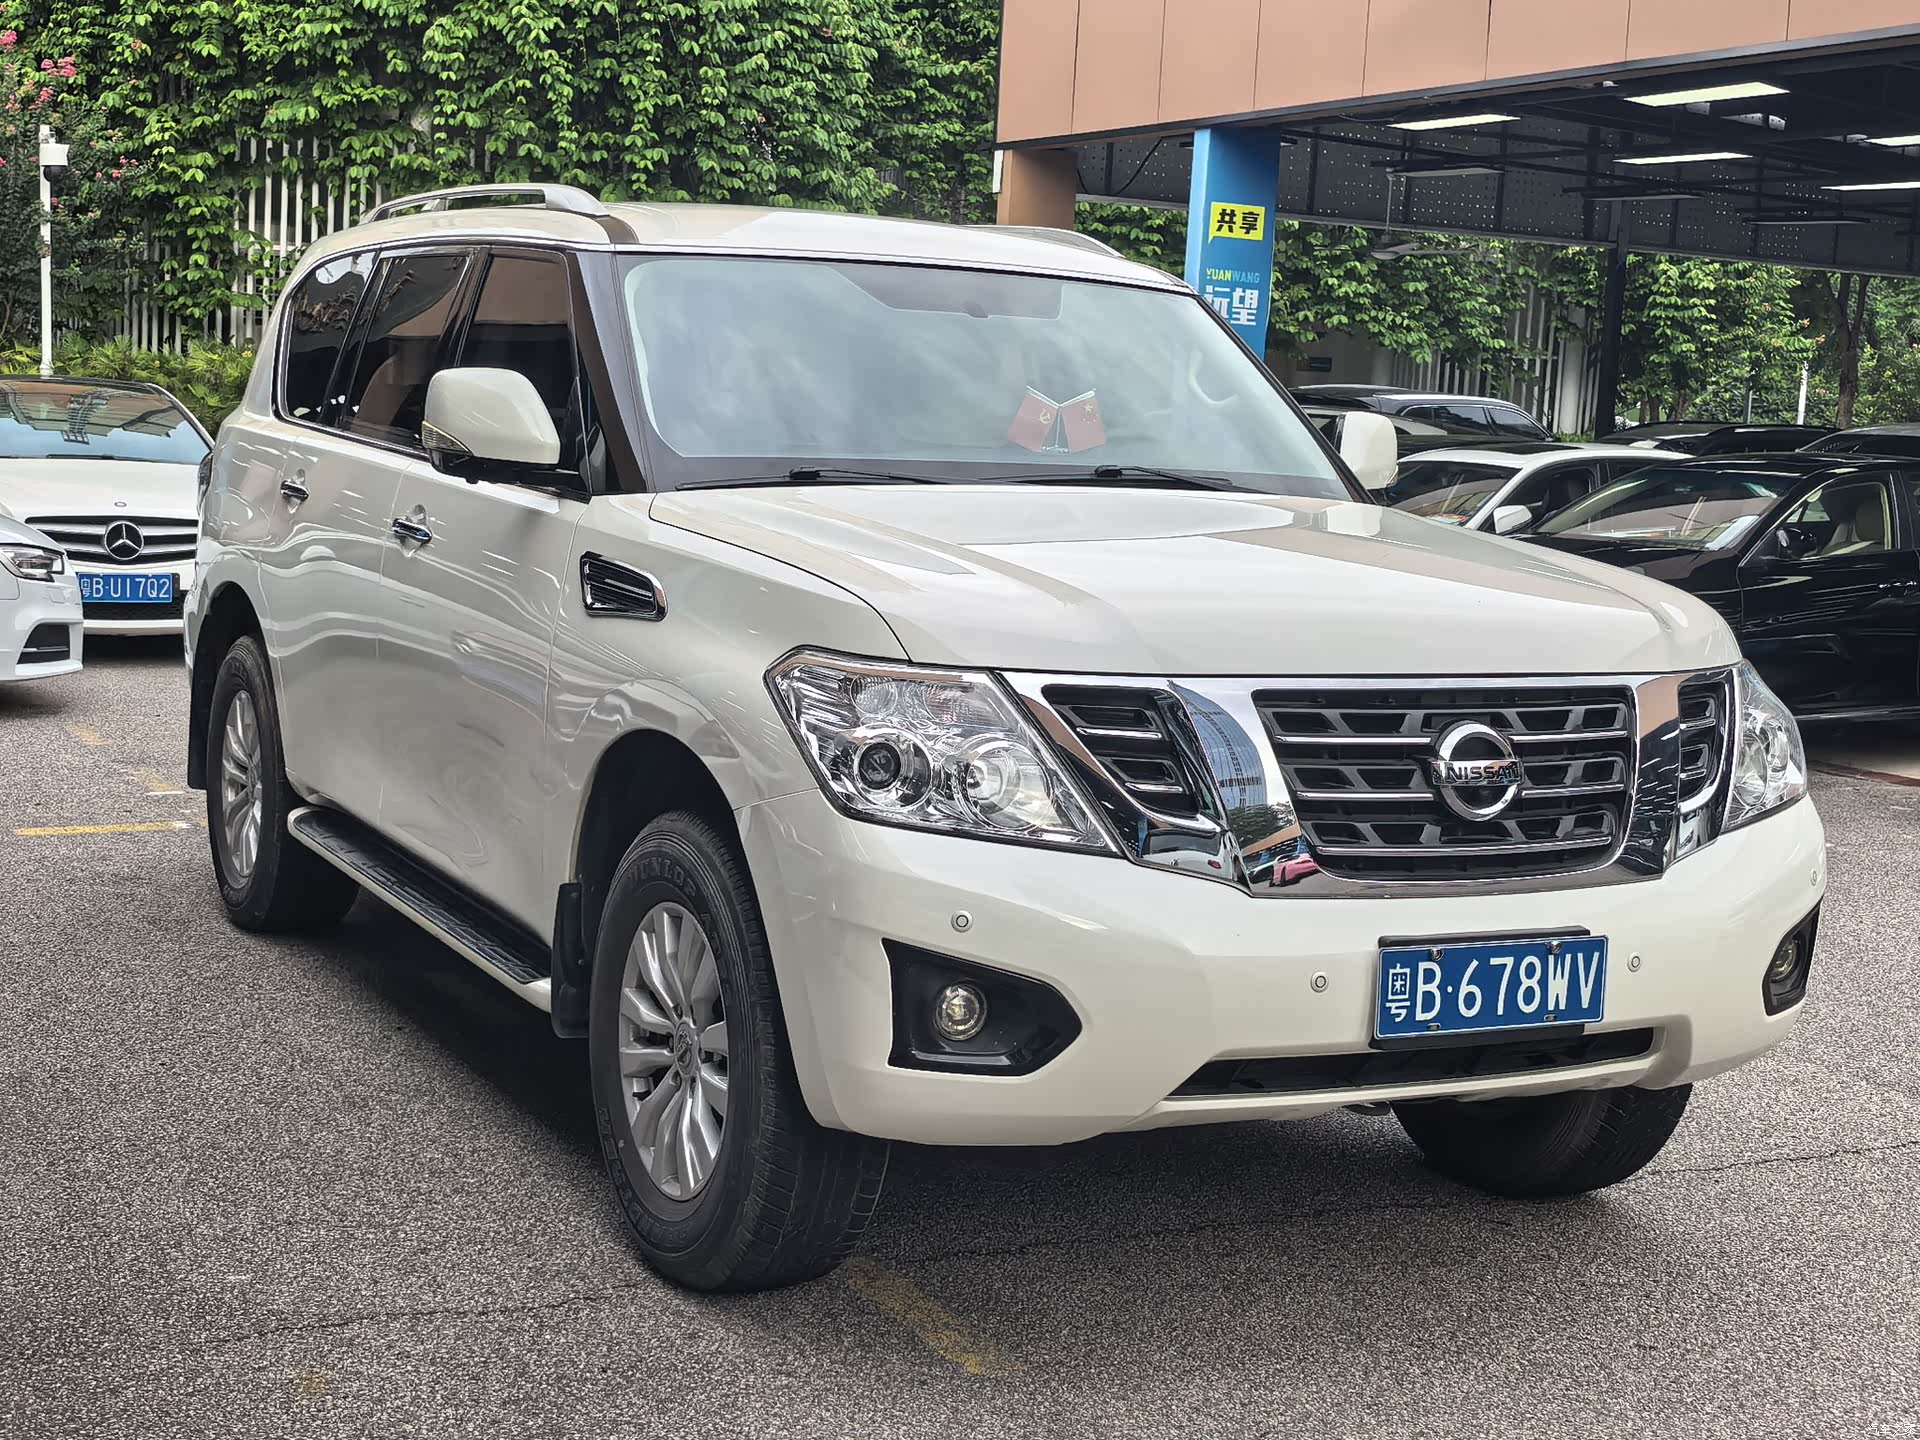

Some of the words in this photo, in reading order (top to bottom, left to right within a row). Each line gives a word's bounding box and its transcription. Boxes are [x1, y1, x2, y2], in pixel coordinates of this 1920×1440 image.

[1216, 208, 1260, 235] 共享
[1206, 267, 1261, 284] YUANWANG
[1444, 761, 1520, 782] NISSAN
